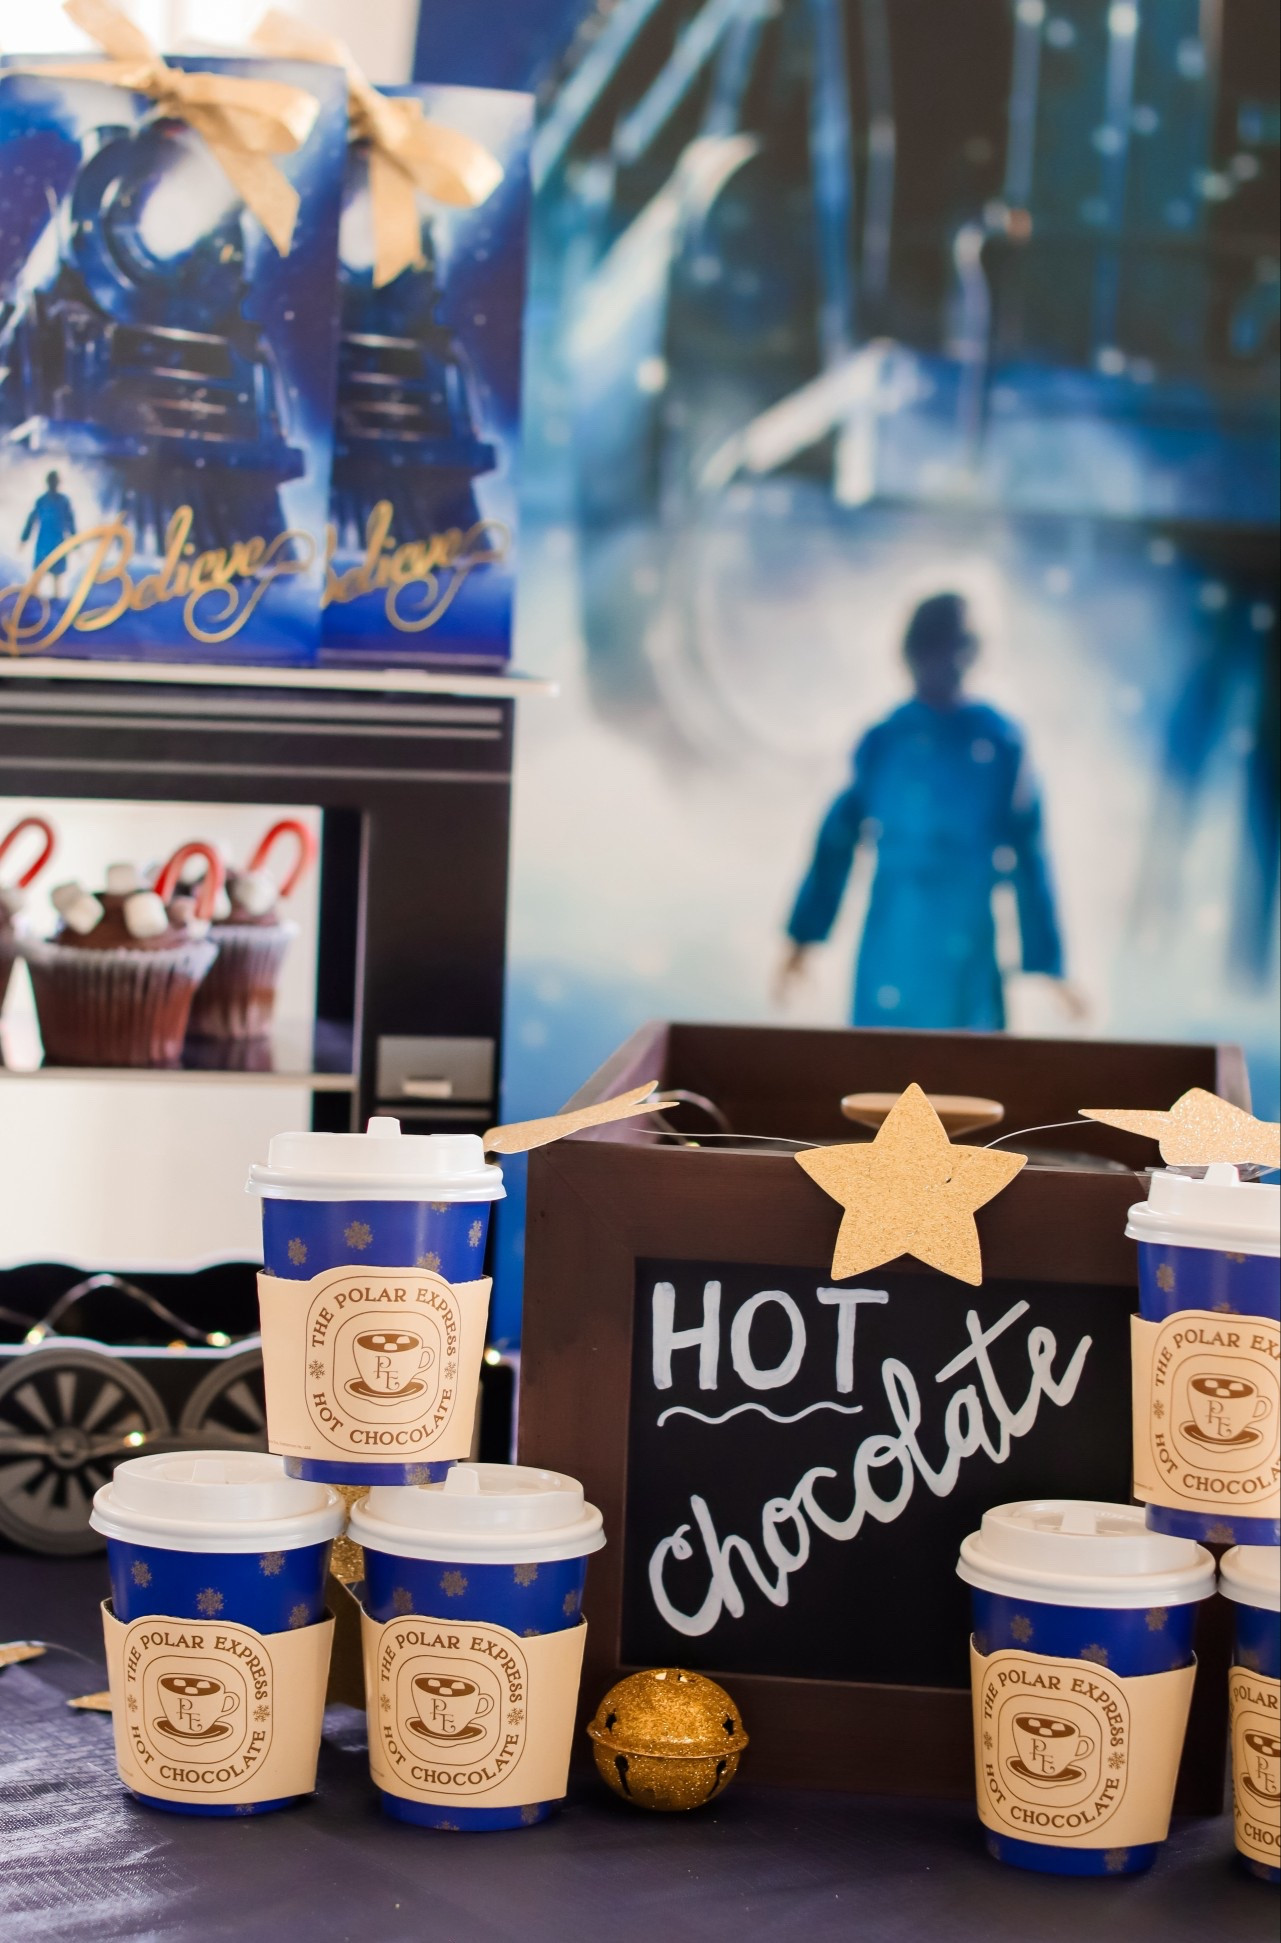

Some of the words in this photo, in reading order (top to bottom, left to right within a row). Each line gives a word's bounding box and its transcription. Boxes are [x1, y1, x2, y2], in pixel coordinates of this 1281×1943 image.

[0, 505, 316, 654] Believe
[312, 1308, 334, 1347] THE
[334, 1288, 406, 1309] POLAR
[416, 1288, 456, 1356] EXPRESS
[652, 1280, 889, 1393] HOT
[1156, 1347, 1173, 1386] THE
[1173, 1329, 1240, 1348] POLAR
[1250, 1335, 1281, 1361] EX
[313, 1392, 344, 1432] HOT
[350, 1389, 452, 1445] CHOCOLATE
[648, 1300, 1093, 1637] Chocolate
[1155, 1433, 1178, 1474] HOT
[1183, 1457, 1281, 1494] CHOCOLA
[127, 1646, 141, 1682] THE
[140, 1632, 204, 1649] POLAR
[214, 1636, 267, 1700] EXPRESS
[381, 1645, 395, 1682] THE
[395, 1631, 460, 1649] POLAR
[470, 1637, 522, 1703] EXPRESS
[1233, 1685, 1278, 1710] POLAR
[984, 1683, 998, 1720] THE
[998, 1669, 1061, 1690] POLAR
[1071, 1678, 1123, 1747] EXPRESS
[131, 1726, 154, 1765] HOT
[159, 1731, 265, 1784] CHOCOLATE
[383, 1726, 406, 1765] HOT
[411, 1734, 518, 1785] CHOCOLATE
[986, 1764, 1005, 1804] HOT
[1010, 1778, 1119, 1829] CHOCOLATE
